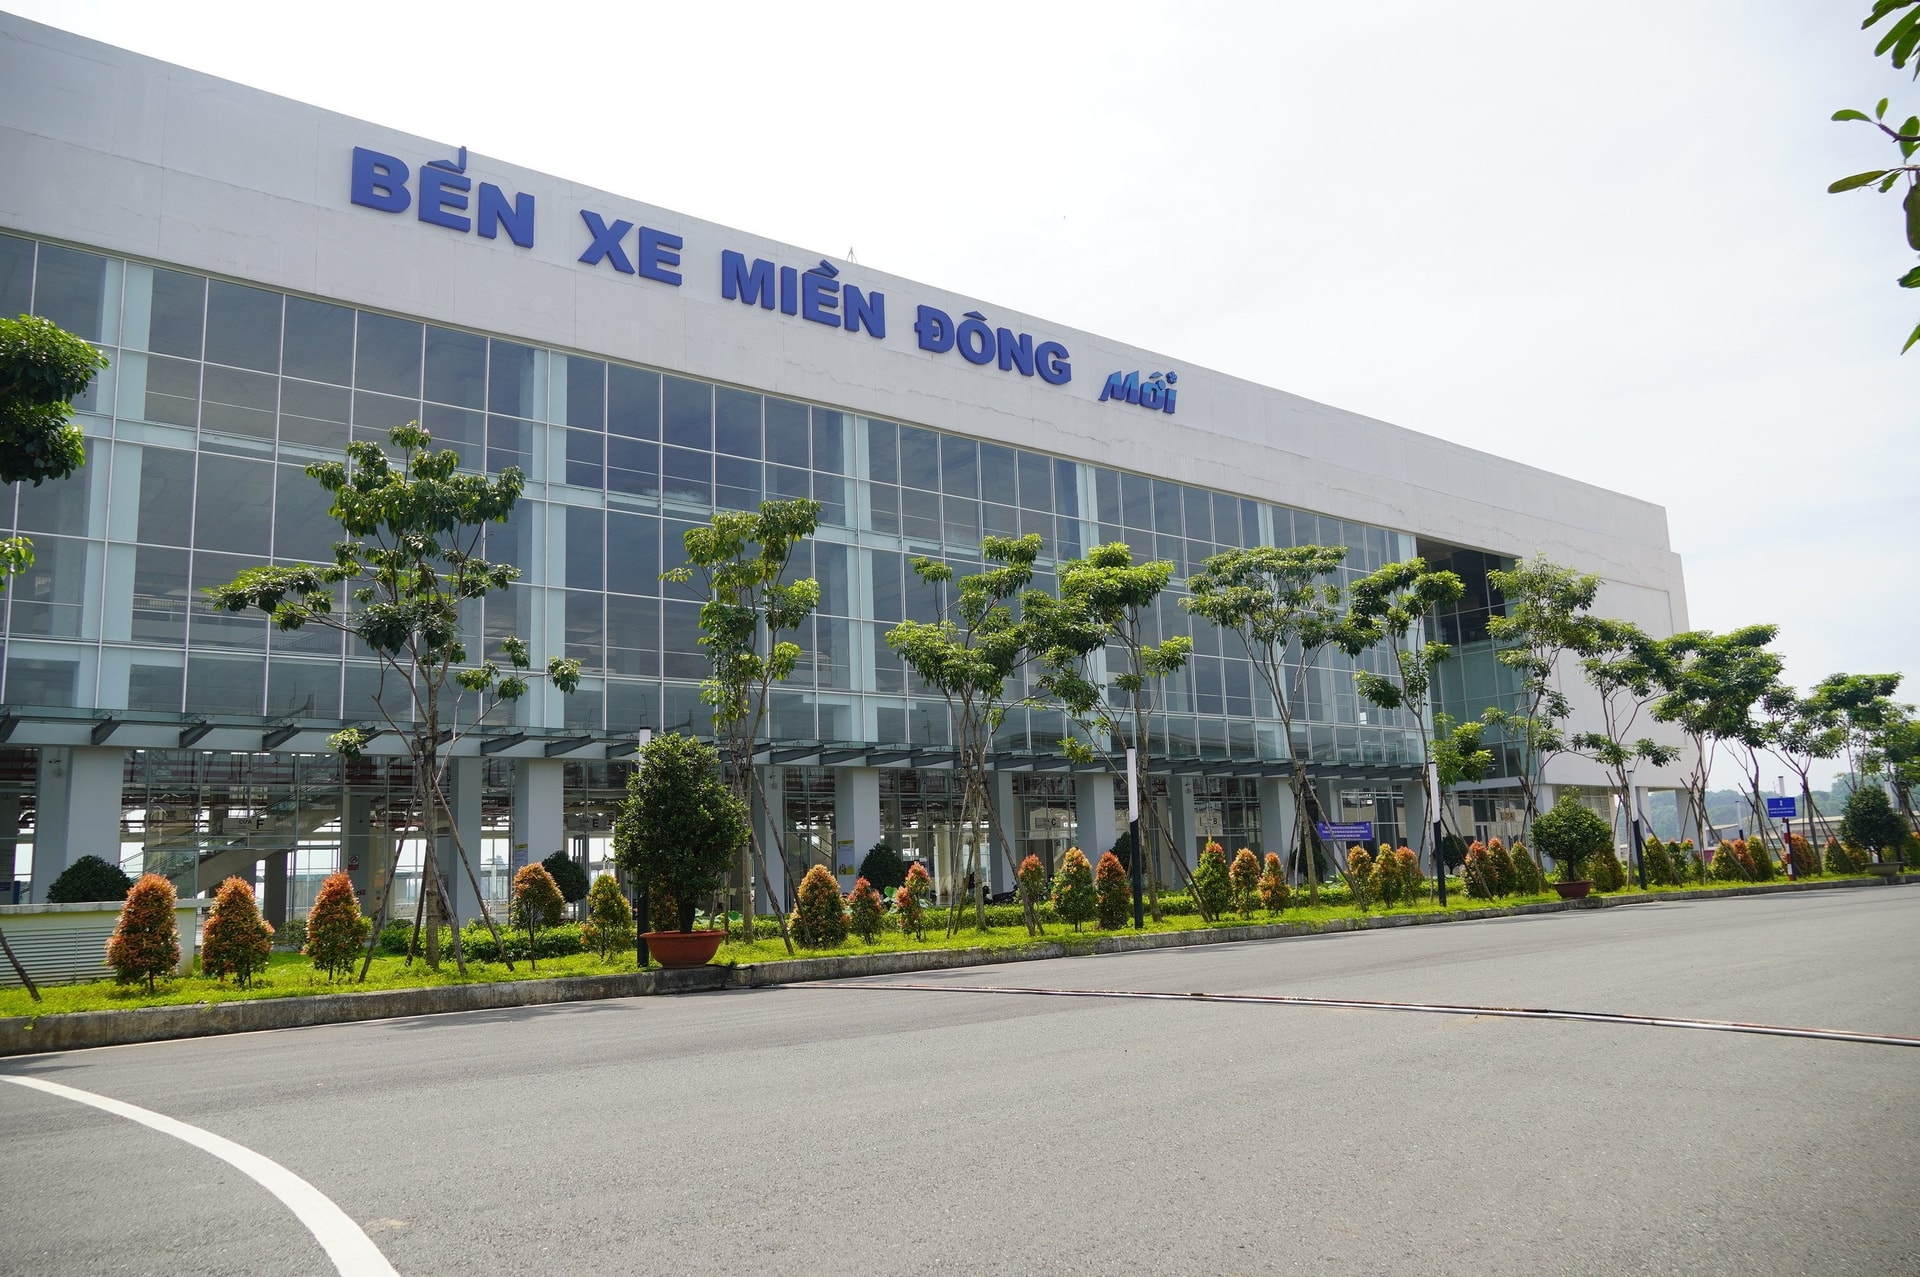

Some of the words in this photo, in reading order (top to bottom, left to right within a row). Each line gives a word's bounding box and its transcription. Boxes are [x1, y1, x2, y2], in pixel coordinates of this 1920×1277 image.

[351, 145, 535, 248] BẾN
[578, 209, 683, 286] XE
[722, 249, 885, 339] MIỀN
[914, 304, 1072, 385] ĐÔNG
[256, 819, 264, 829] F
[593, 819, 599, 827] E
